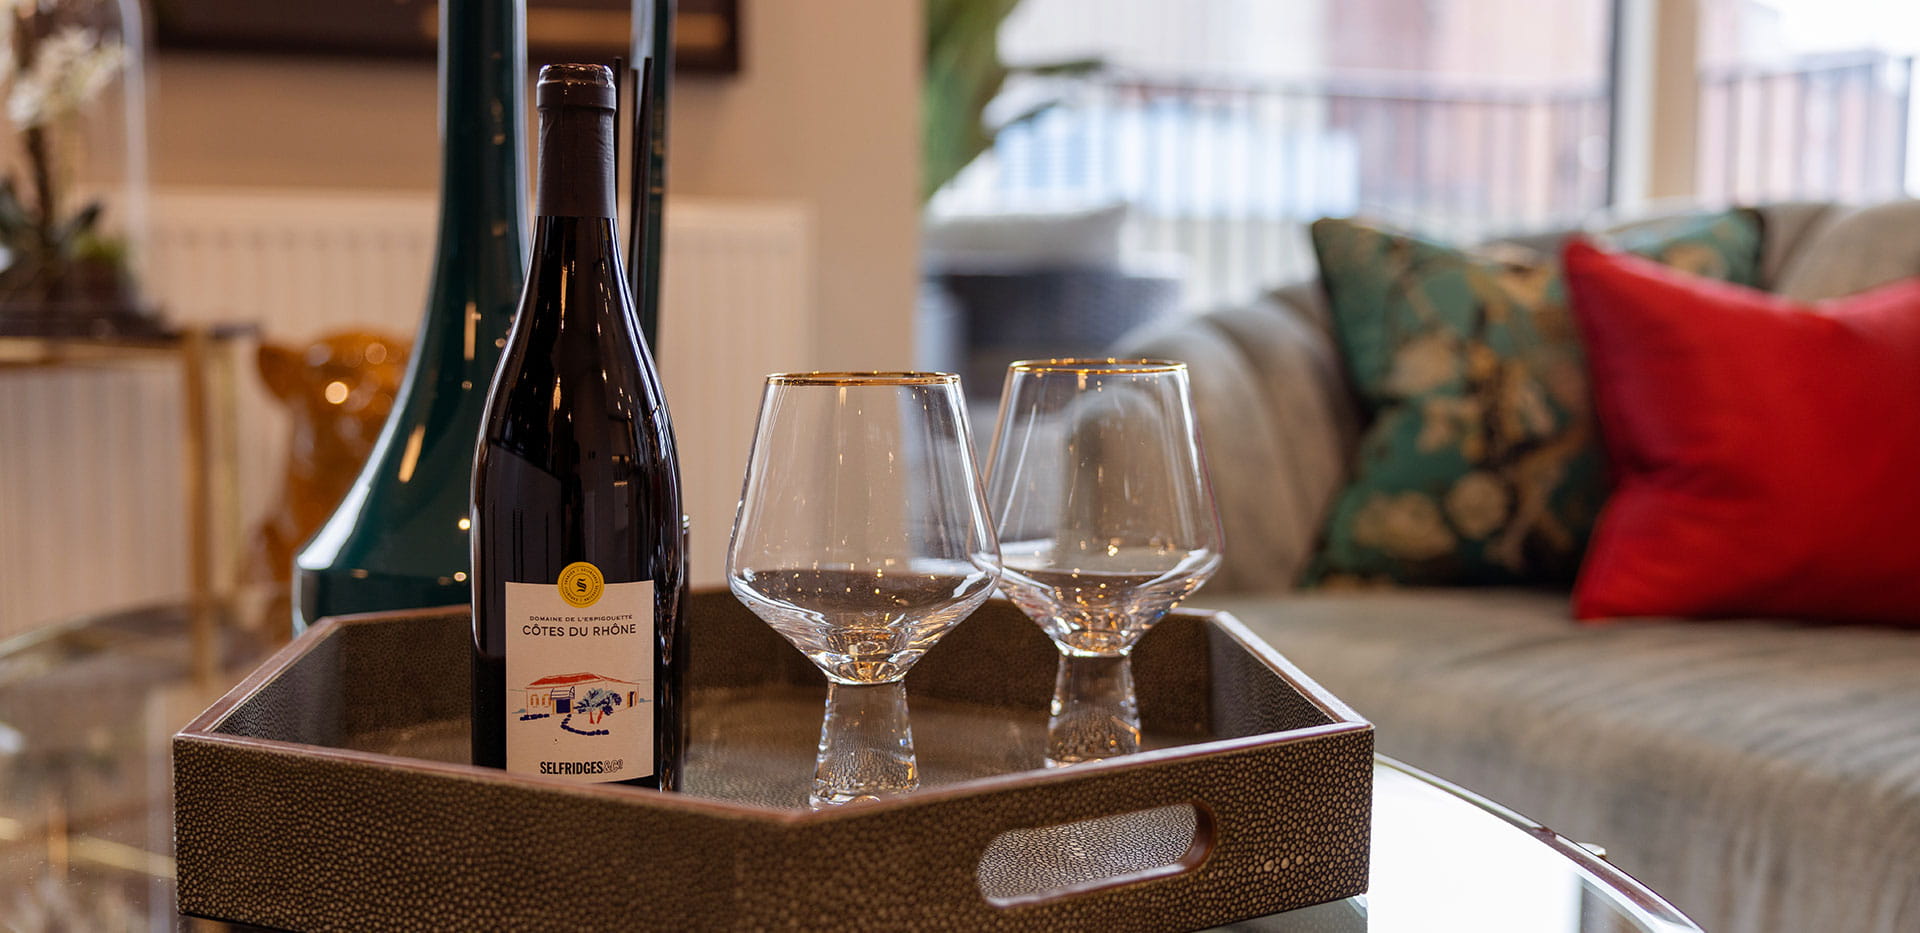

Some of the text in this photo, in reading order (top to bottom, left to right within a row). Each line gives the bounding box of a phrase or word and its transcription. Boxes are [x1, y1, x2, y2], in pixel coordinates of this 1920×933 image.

[577, 614, 633, 622] L'ESPIGOUETTE
[522, 622, 637, 637] CÔTES DU RHÔNE
